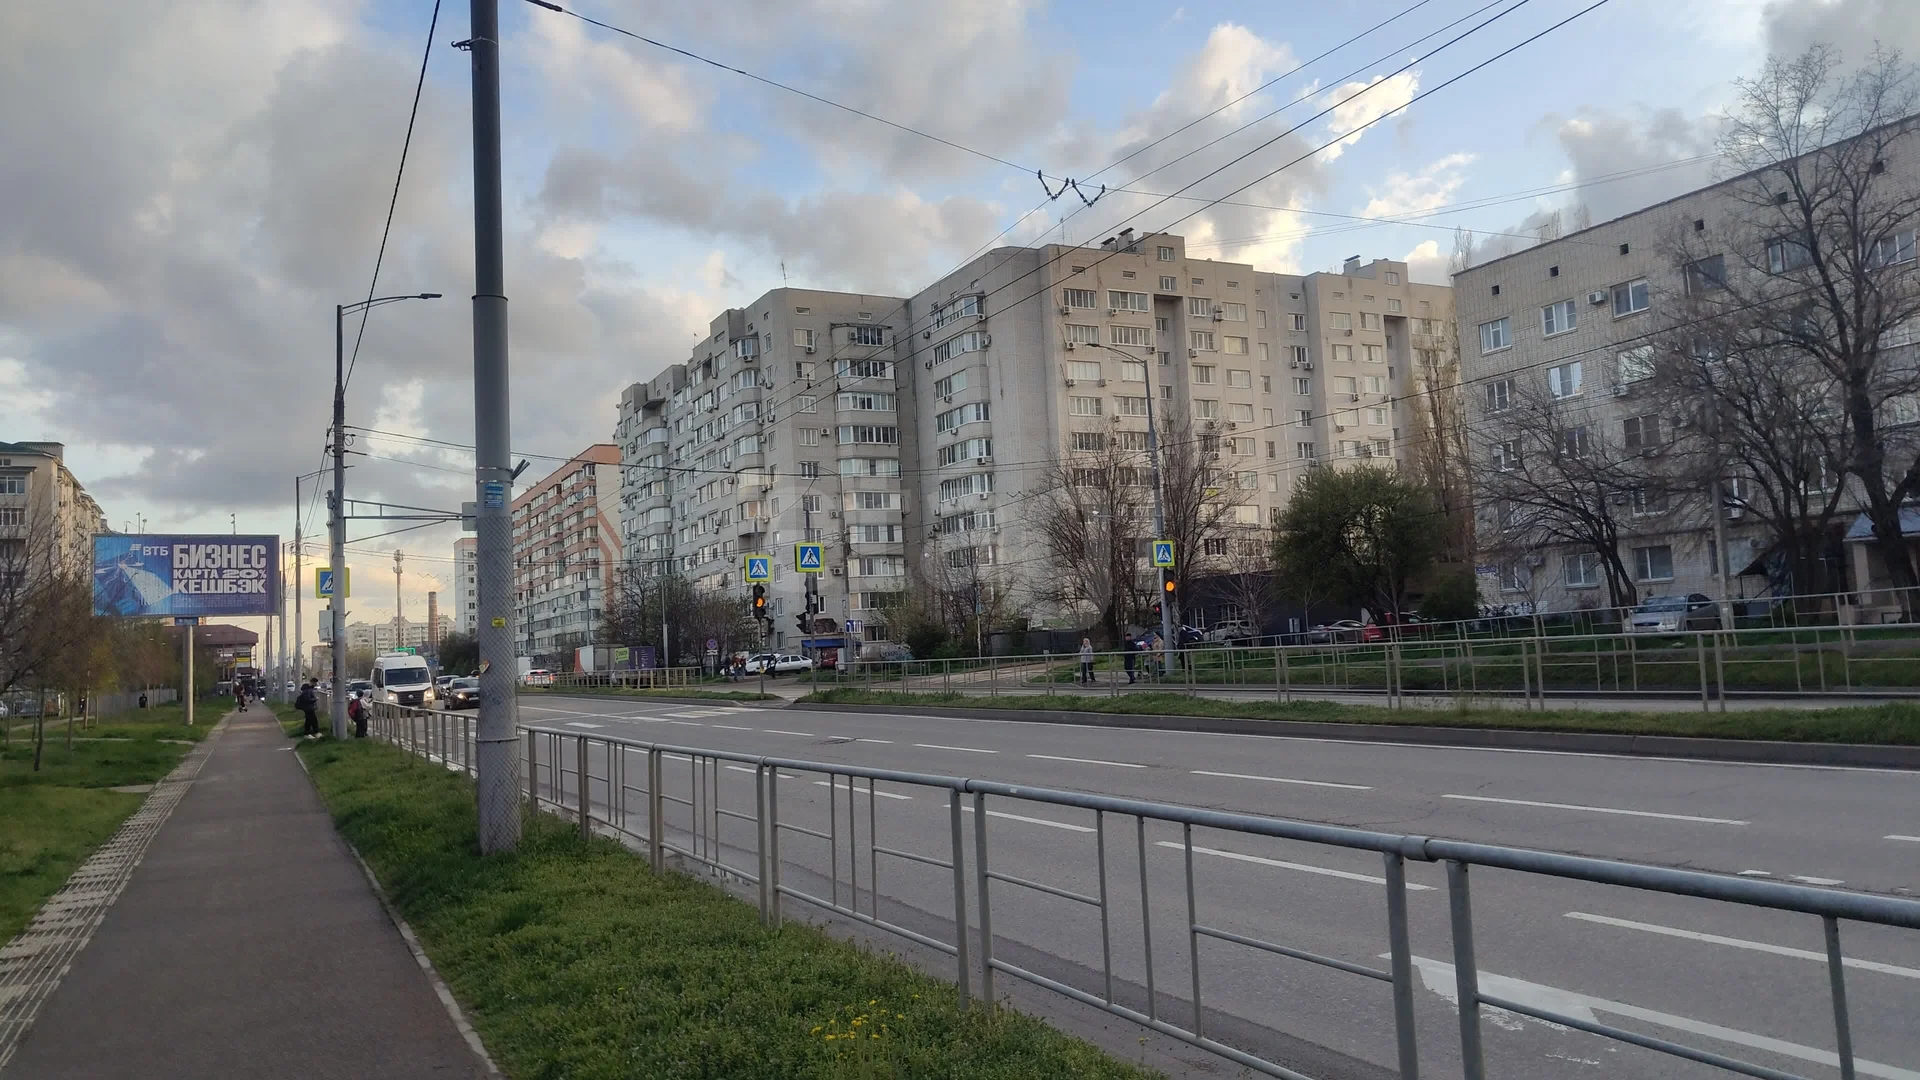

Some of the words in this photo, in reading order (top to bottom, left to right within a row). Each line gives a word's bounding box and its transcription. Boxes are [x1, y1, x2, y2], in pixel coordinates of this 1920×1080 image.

[143, 546, 168, 556] ВТБ
[173, 544, 267, 569] БИЗНЕС
[173, 569, 219, 579] КАРТА
[222, 569, 267, 579] 20%
[173, 579, 267, 594] КЕШБЭК
